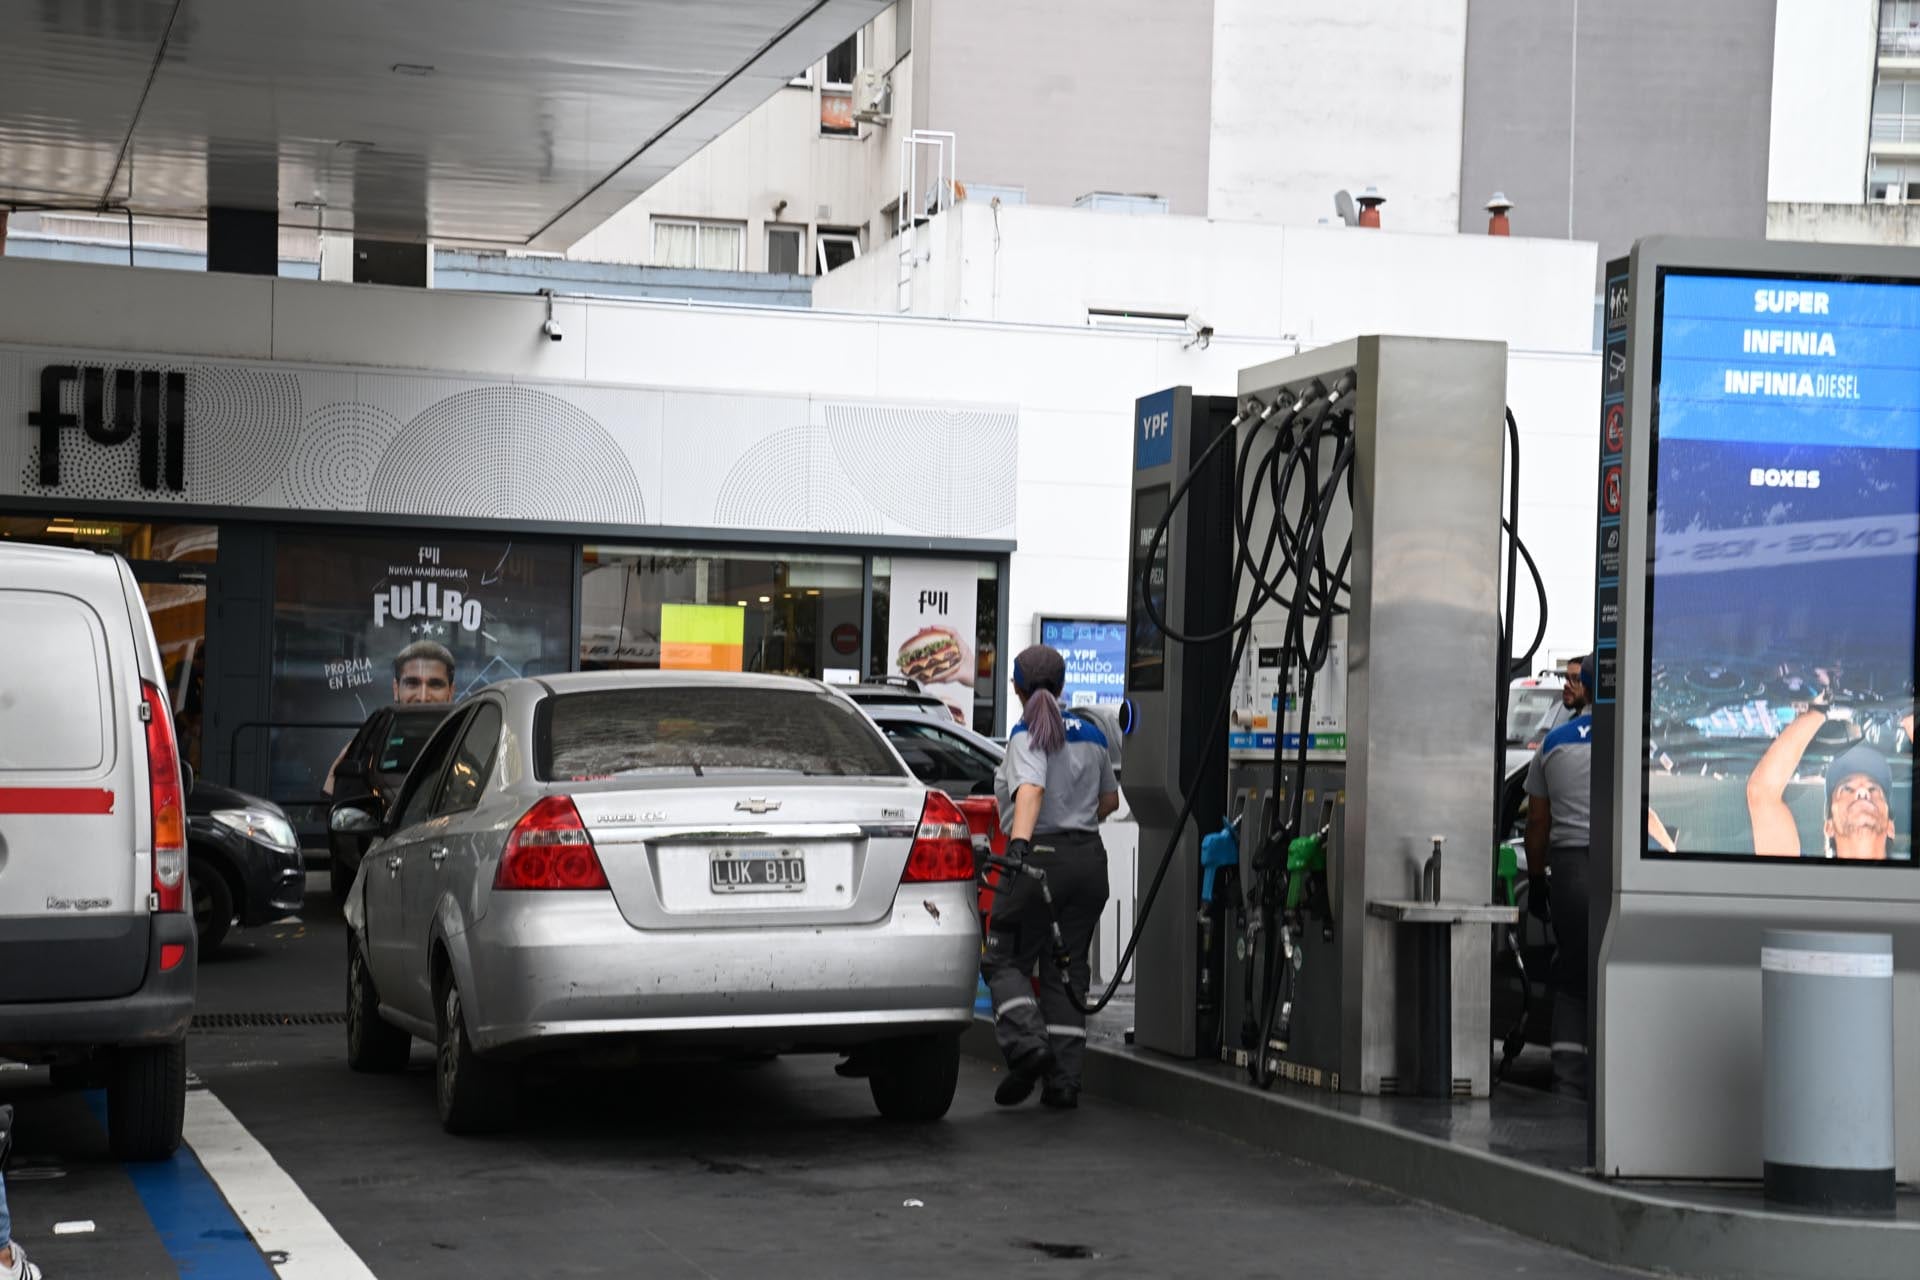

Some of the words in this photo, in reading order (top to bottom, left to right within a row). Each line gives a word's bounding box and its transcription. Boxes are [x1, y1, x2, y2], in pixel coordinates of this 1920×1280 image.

[1753, 289, 1830, 315] SUPER
[1742, 329, 1837, 357] INFINIA
[1815, 374, 1861, 400] DIESEL
[1143, 411, 1169, 440] YPF
[1749, 468, 1821, 489] BOXES
[388, 565, 413, 577] NUEVA
[414, 567, 468, 579] HAMBURGUESA
[373, 580, 482, 631] FULLBO
[918, 590, 949, 616] full
[324, 656, 372, 679] PROBALA
[1067, 660, 1112, 673] MUNDO
[328, 675, 343, 690] EN
[347, 671, 373, 689] FULL
[715, 860, 753, 884] LUK
[765, 860, 803, 883] 810
